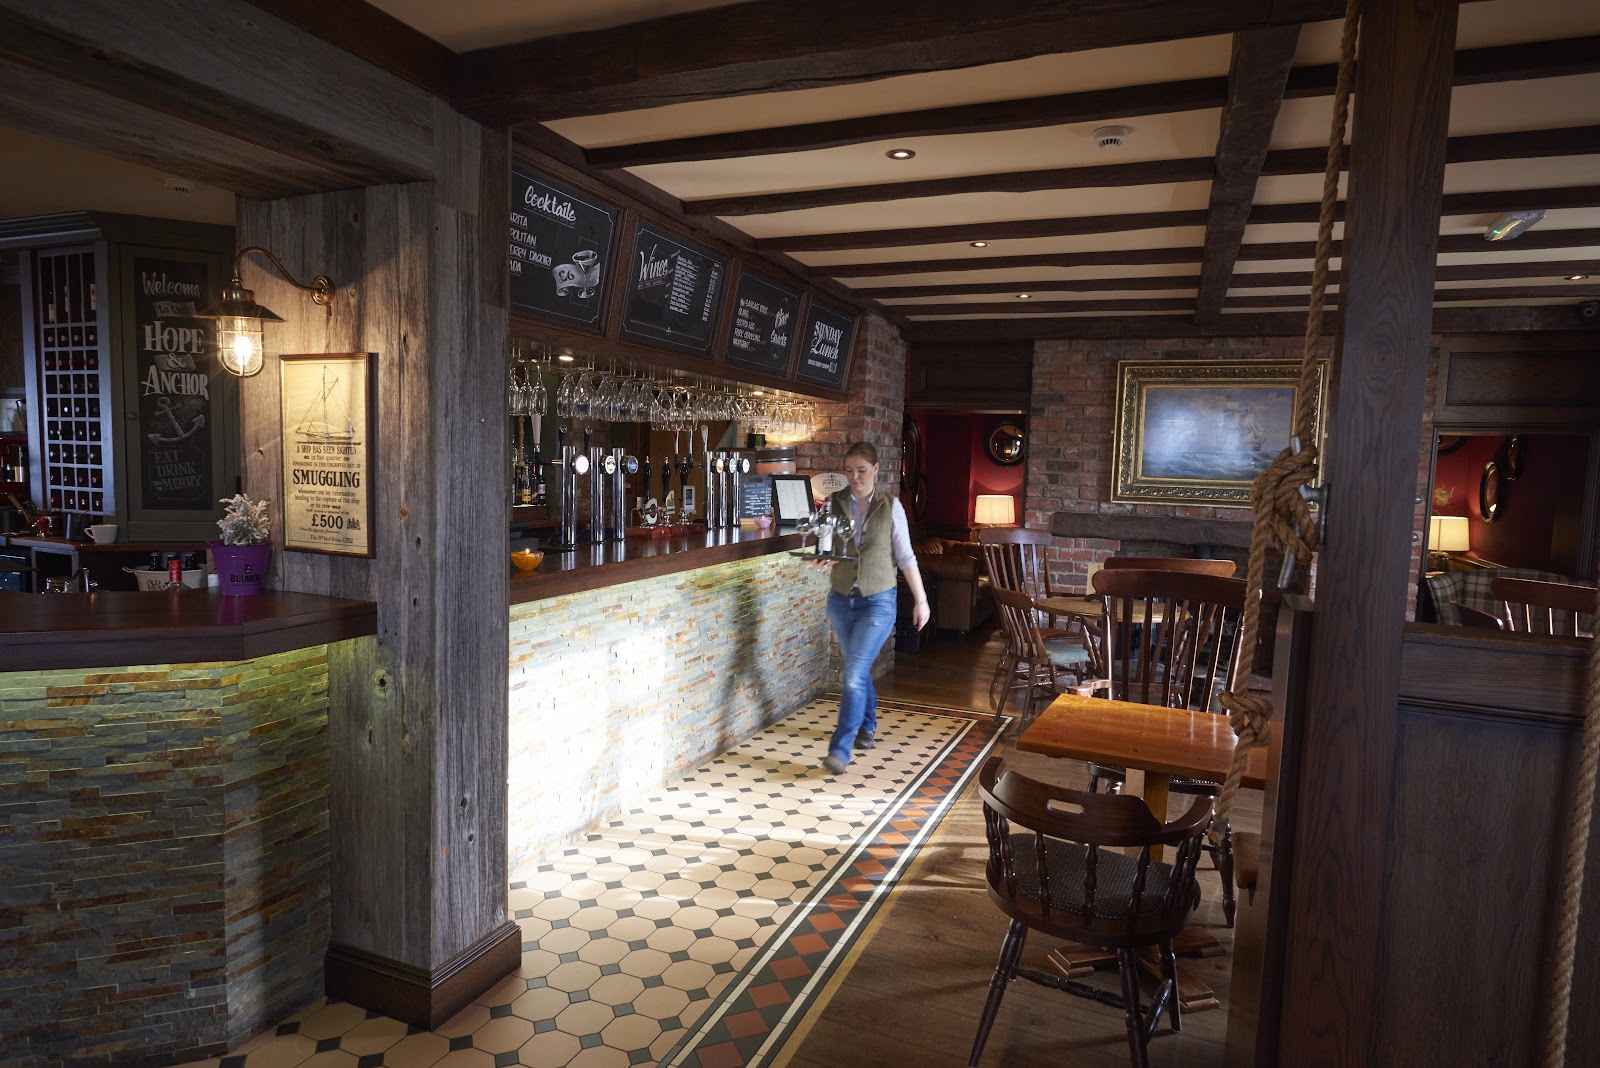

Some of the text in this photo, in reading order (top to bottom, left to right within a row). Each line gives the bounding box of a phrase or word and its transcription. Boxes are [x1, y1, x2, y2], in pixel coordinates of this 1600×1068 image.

[524, 185, 577, 222] Cocktails
[639, 243, 668, 282] Wines
[142, 271, 201, 297] Welcome
[558, 269, 575, 284] £6
[142, 320, 205, 354] HOPE
[814, 321, 843, 344] SUNDAY
[810, 336, 839, 360] Lunch
[167, 352, 187, 369] &
[140, 364, 209, 401] ANCHOR
[153, 450, 183, 464] EAT
[301, 445, 312, 454] SHIP
[313, 445, 322, 454] HAS
[323, 446, 335, 455] BEEN
[336, 446, 357, 456] SIGHTED
[155, 462, 198, 477] DRINK
[293, 469, 361, 488] SMUGGLING
[161, 475, 202, 491] MERRY
[311, 513, 344, 529] £500
